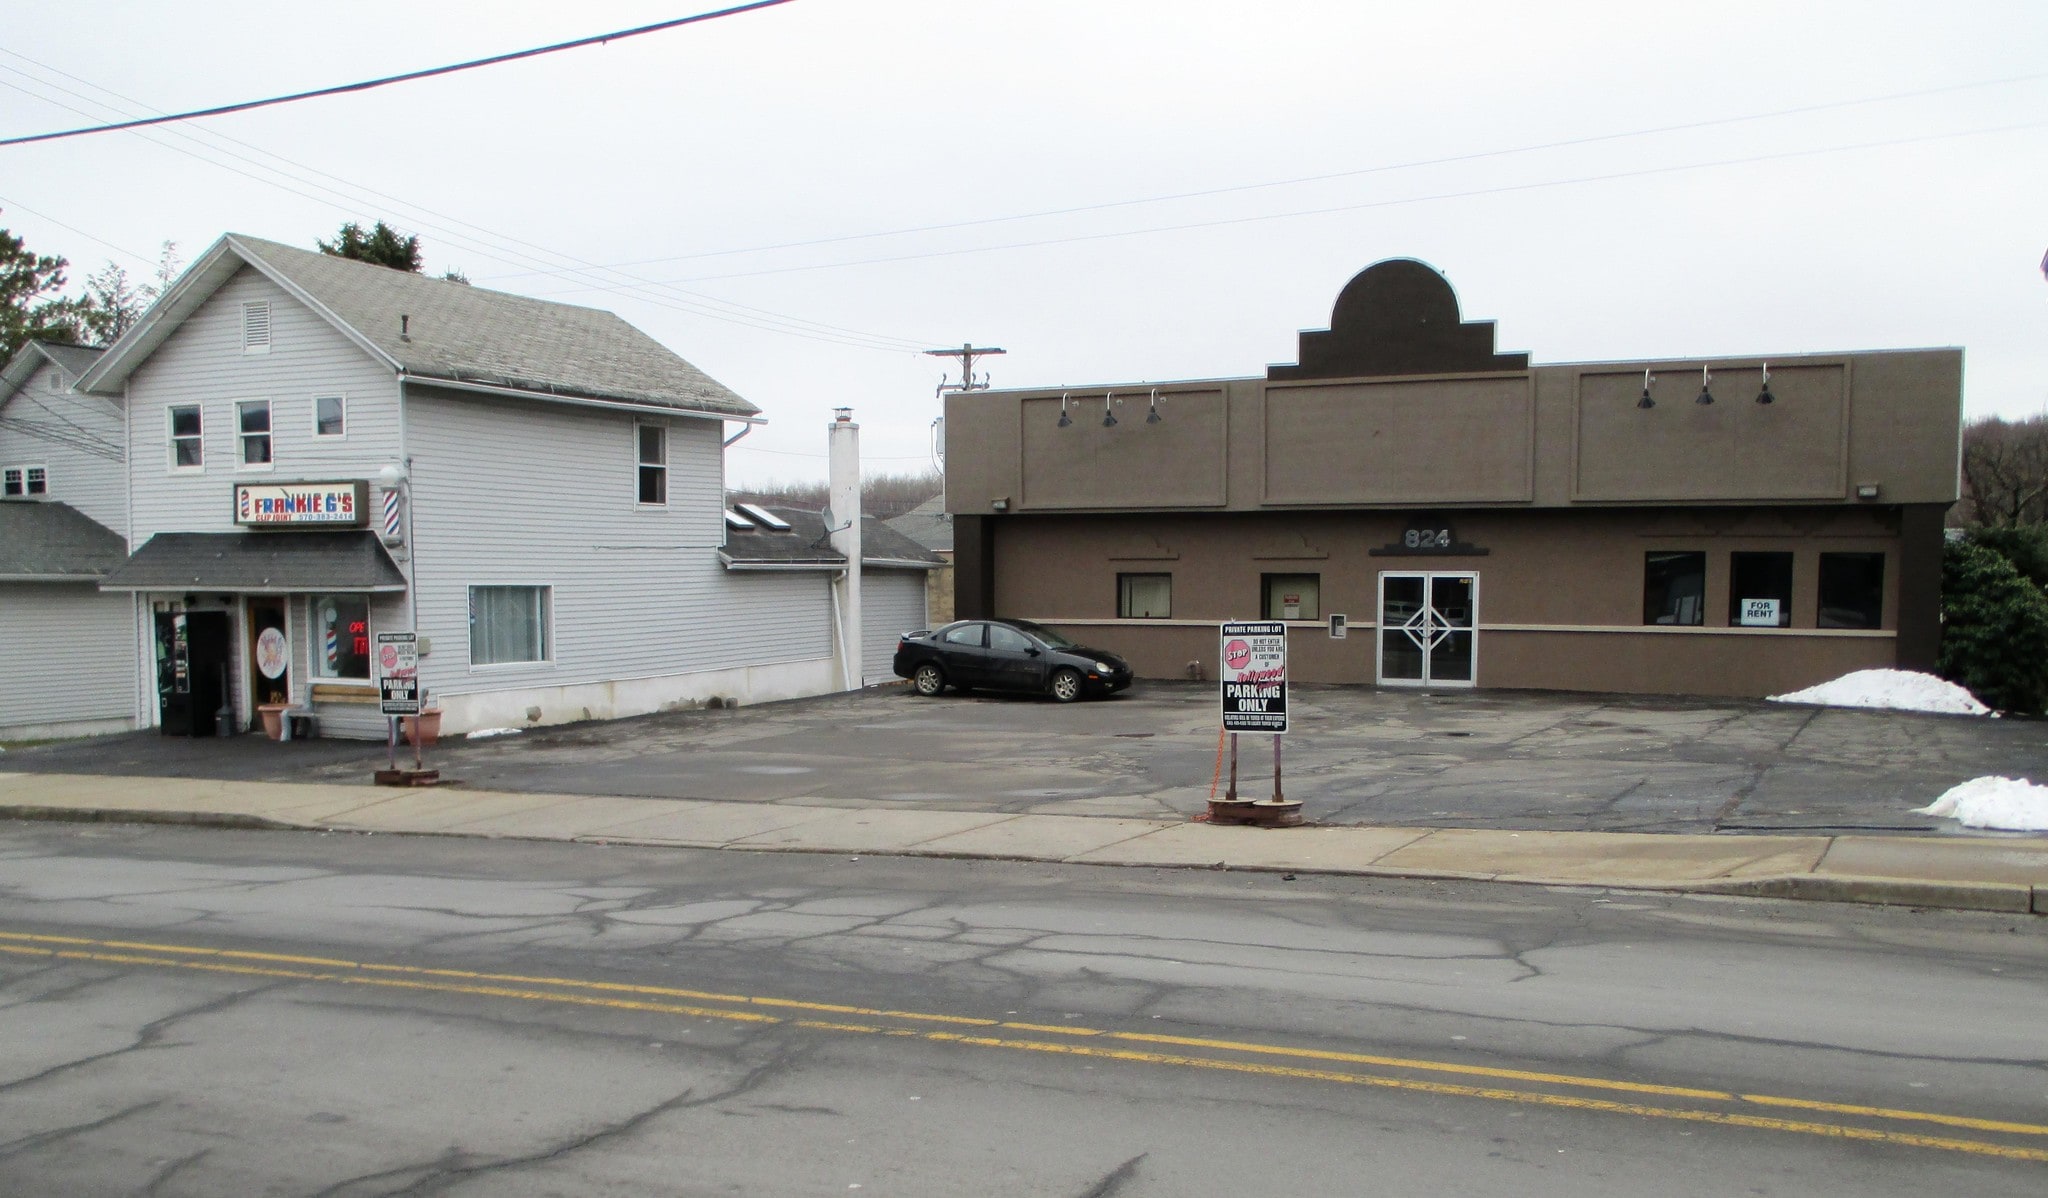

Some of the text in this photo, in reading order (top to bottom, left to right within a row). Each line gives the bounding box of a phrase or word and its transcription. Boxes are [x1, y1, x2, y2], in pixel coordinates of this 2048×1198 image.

[255, 493, 353, 513] FRANKIE G'S
[1405, 529, 1451, 548] 824
[1747, 610, 1773, 618] RENT
[1228, 649, 1248, 661] STOP
[1237, 665, 1284, 683] Hollywood
[383, 679, 415, 689] PARKING
[1227, 684, 1281, 698] PARKING
[391, 690, 409, 700] ONLY
[1238, 698, 1269, 712] ONLY
